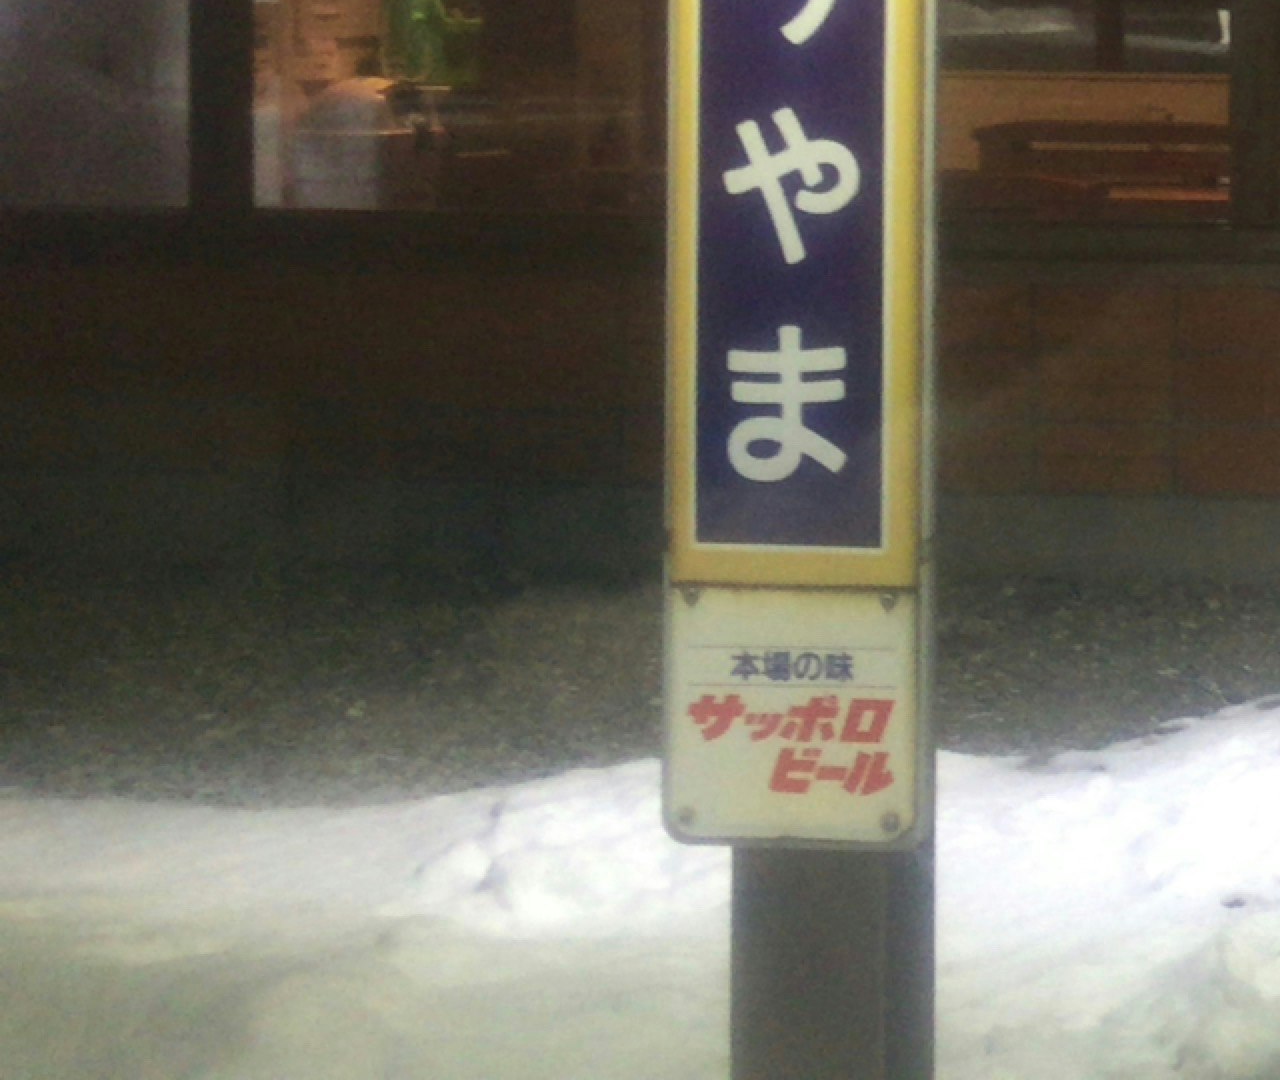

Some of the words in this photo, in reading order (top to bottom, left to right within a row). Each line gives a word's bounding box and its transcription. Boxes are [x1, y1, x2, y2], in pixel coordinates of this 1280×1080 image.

[730, 651, 854, 680] 本場の味
[687, 694, 895, 743] サッポロ
[769, 747, 894, 795] ビール
